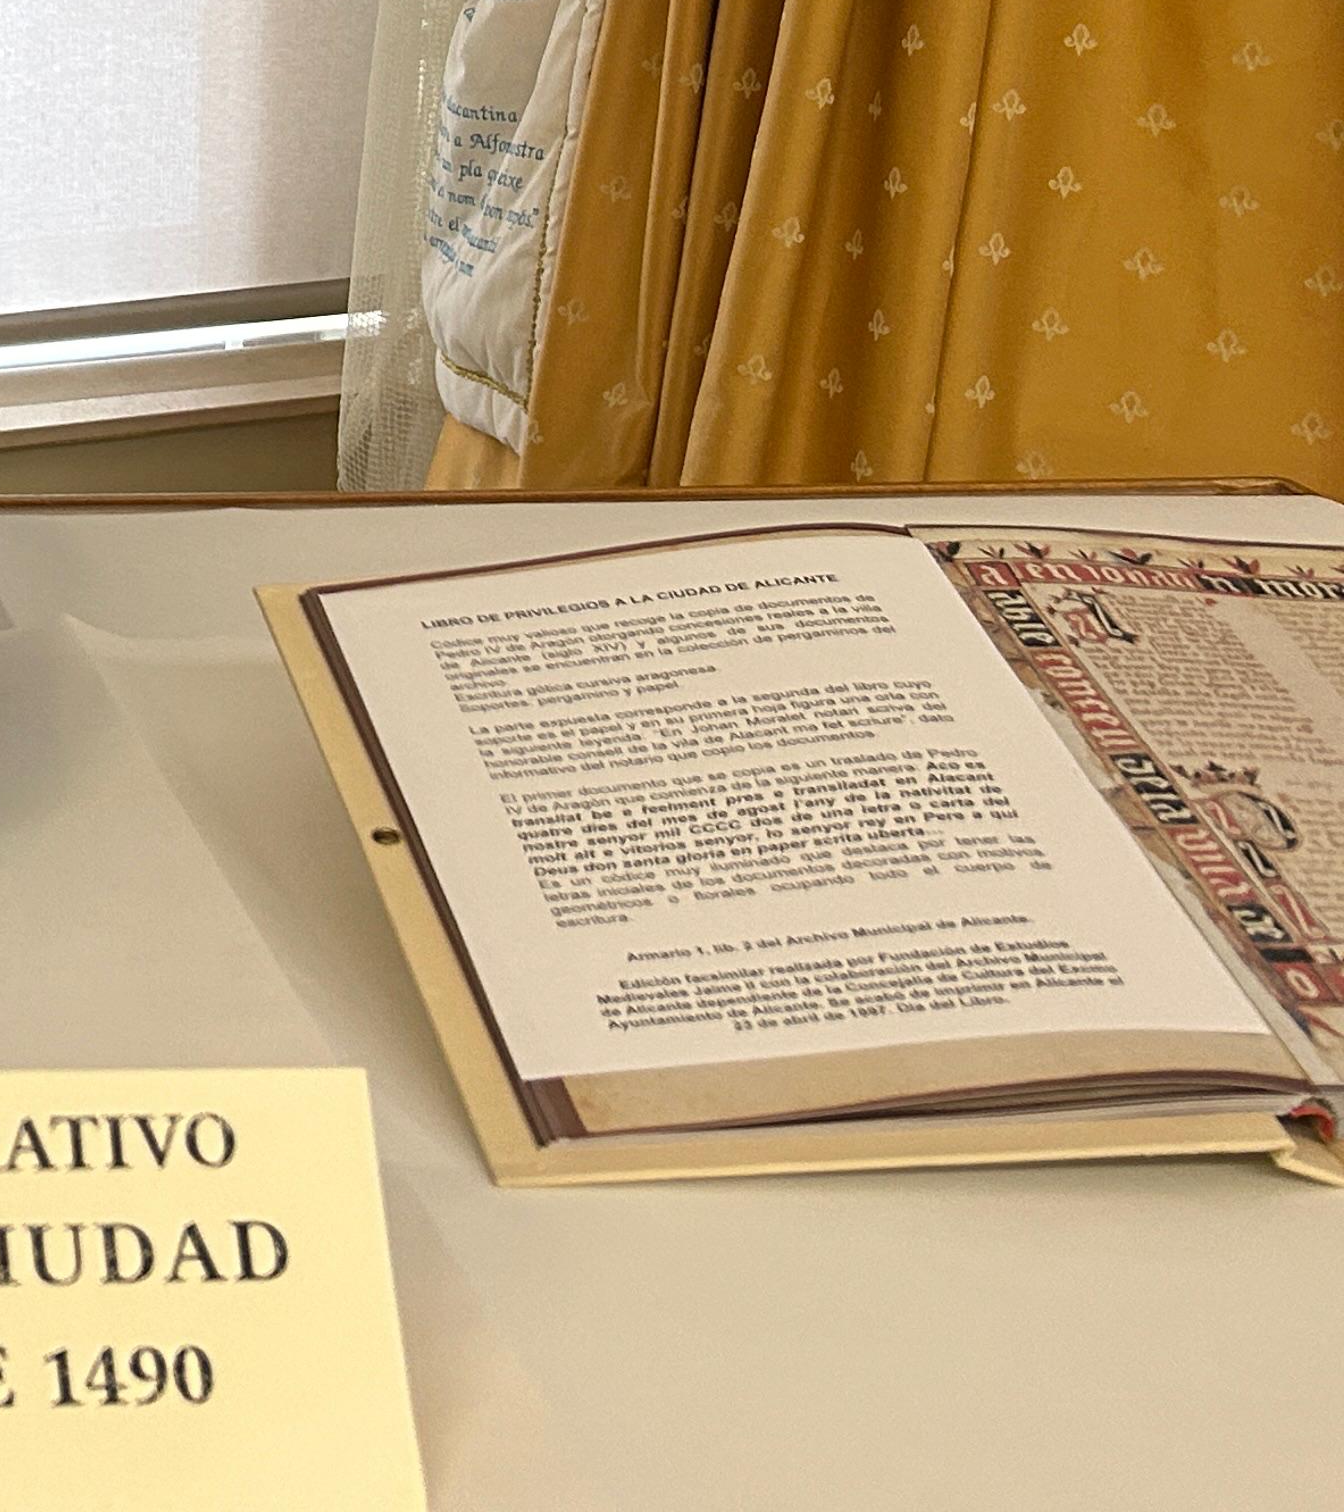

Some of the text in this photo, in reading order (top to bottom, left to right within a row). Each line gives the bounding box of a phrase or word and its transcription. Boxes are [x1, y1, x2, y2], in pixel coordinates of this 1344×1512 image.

[420, 574, 838, 629] LIBRO DE PRIVILEGIOS A LA CIUDAD DE ALICANTE
[44, 1346, 214, 1407] 1490
